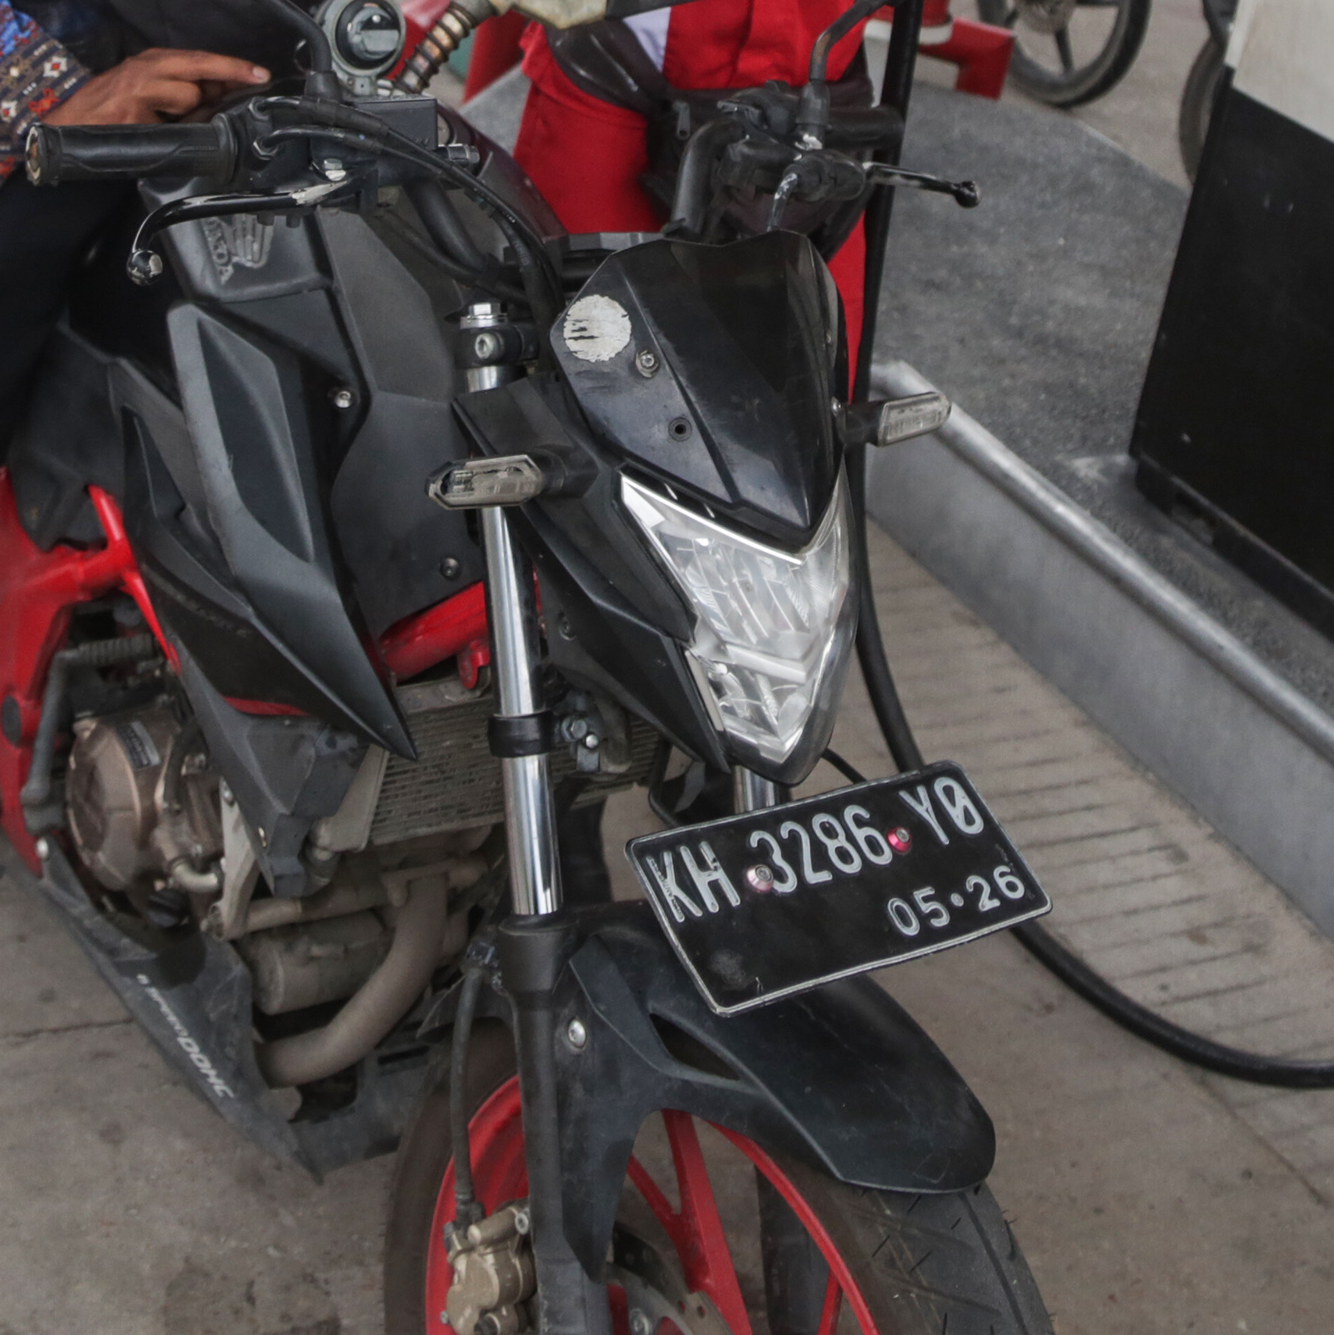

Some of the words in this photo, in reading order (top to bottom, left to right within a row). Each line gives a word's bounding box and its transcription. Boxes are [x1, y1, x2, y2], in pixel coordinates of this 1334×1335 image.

[646, 840, 741, 923] KH
[749, 804, 894, 895] 3286
[176, 1036, 236, 1099] DOHC
